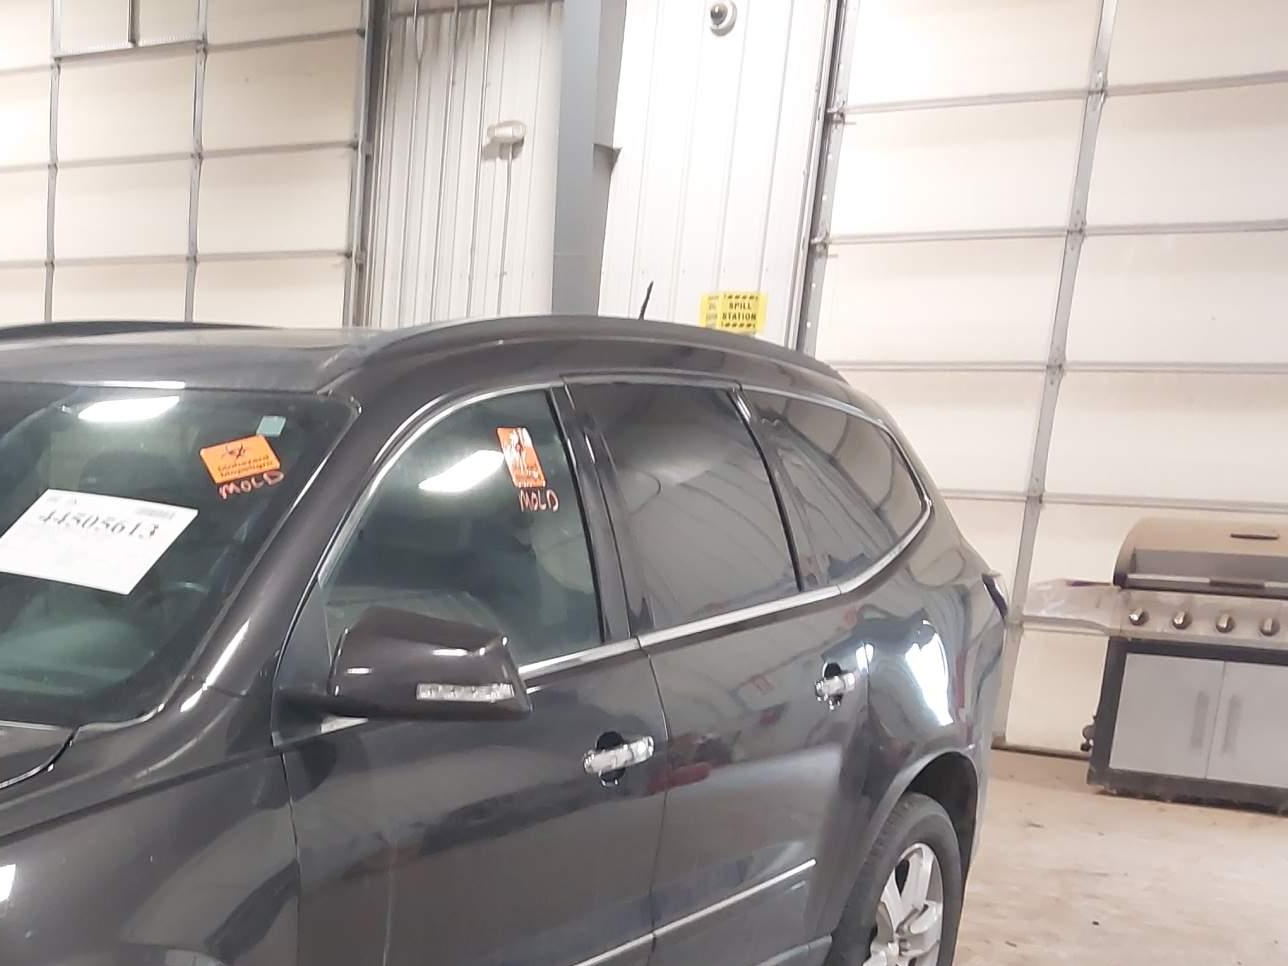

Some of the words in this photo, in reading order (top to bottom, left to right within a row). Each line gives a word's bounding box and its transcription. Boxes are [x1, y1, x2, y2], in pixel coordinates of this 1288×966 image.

[721, 312, 757, 321] STATION
[728, 302, 752, 310] SPILL
[218, 471, 284, 499] MOLD
[519, 488, 559, 512] MOLD
[38, 509, 160, 540] 44505613
